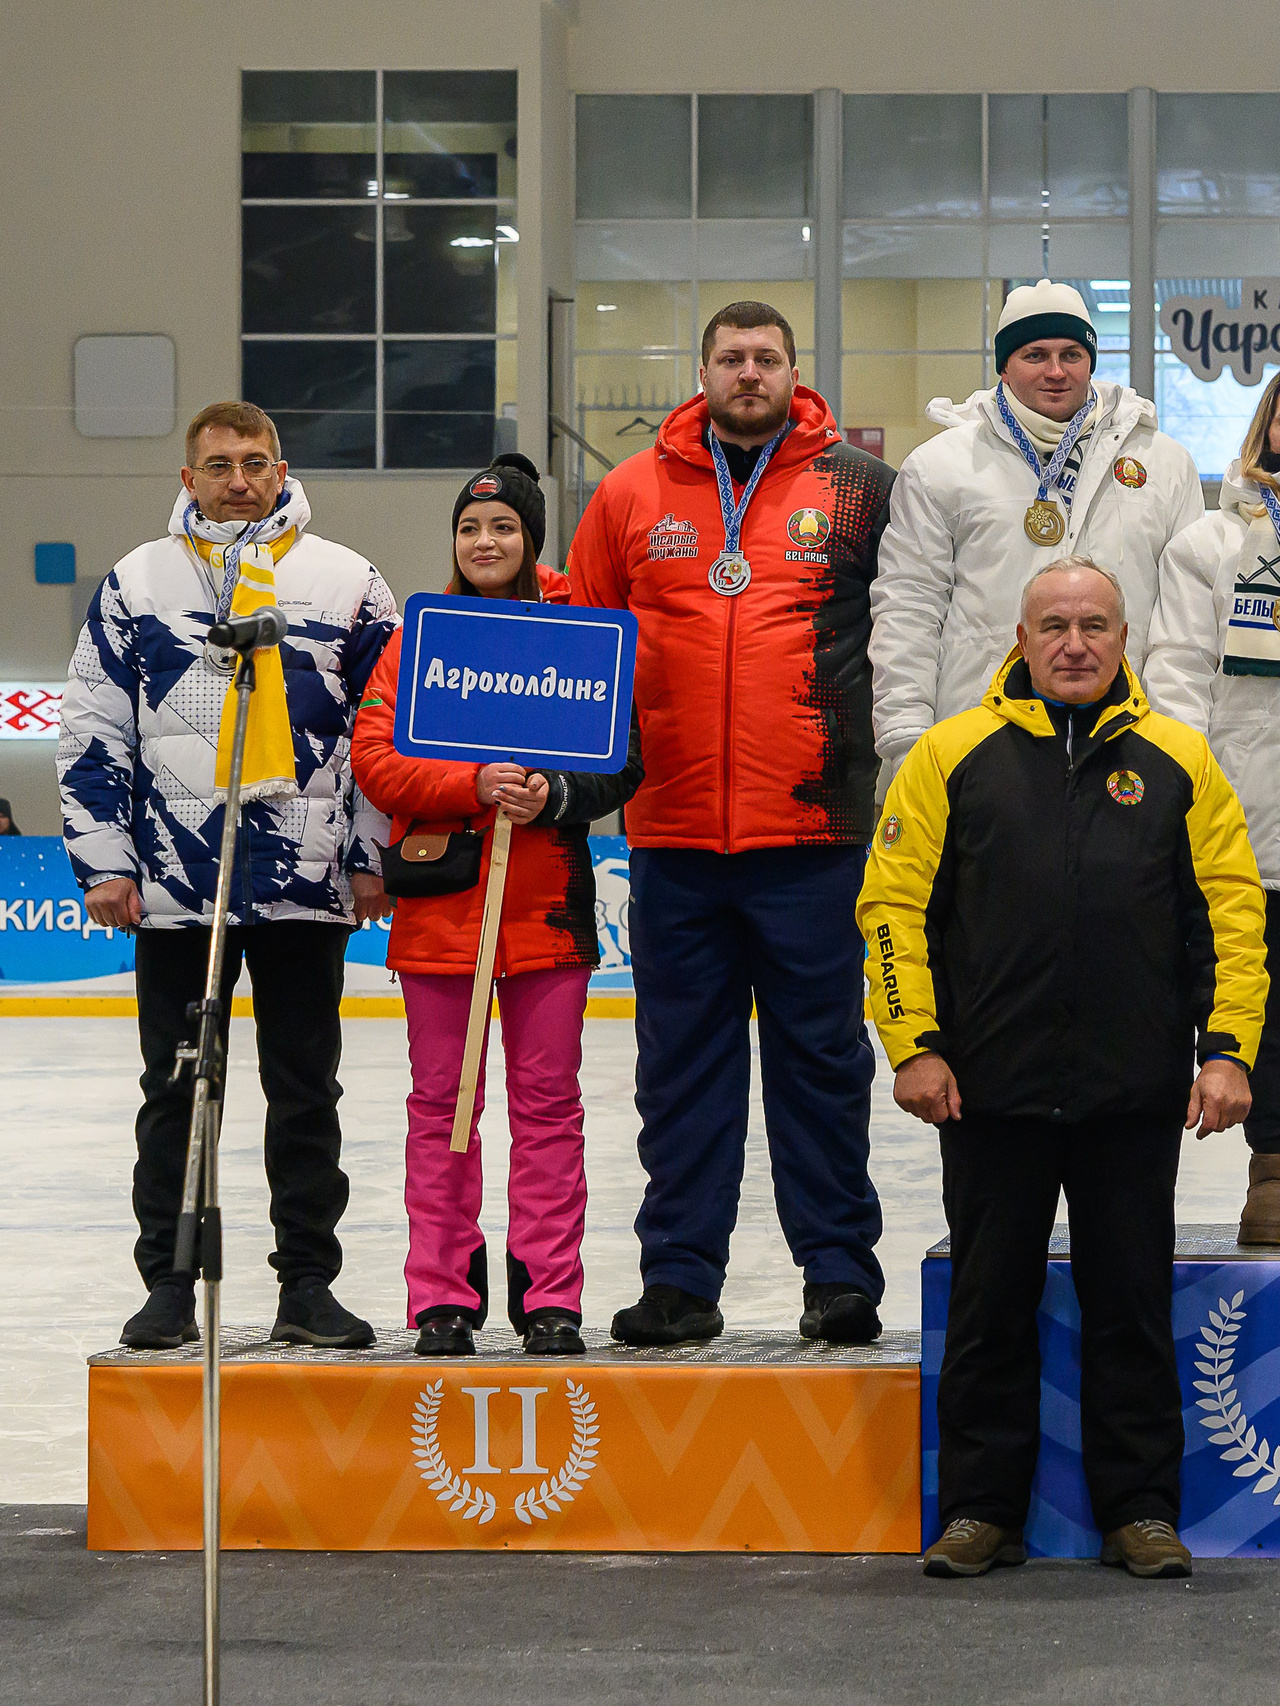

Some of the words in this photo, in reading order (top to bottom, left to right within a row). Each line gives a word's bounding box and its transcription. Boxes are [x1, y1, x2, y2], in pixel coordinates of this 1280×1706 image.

[649, 534, 697, 547] Щедрые
[647, 546, 699, 561] Пружаны
[785, 550, 828, 564] BELARUS
[1234, 597, 1274, 619] БЕЛЫ
[424, 657, 607, 702] Агрохолдинг
[876, 922, 905, 1020] BELARUS
[461, 1387, 549, 1474] II
